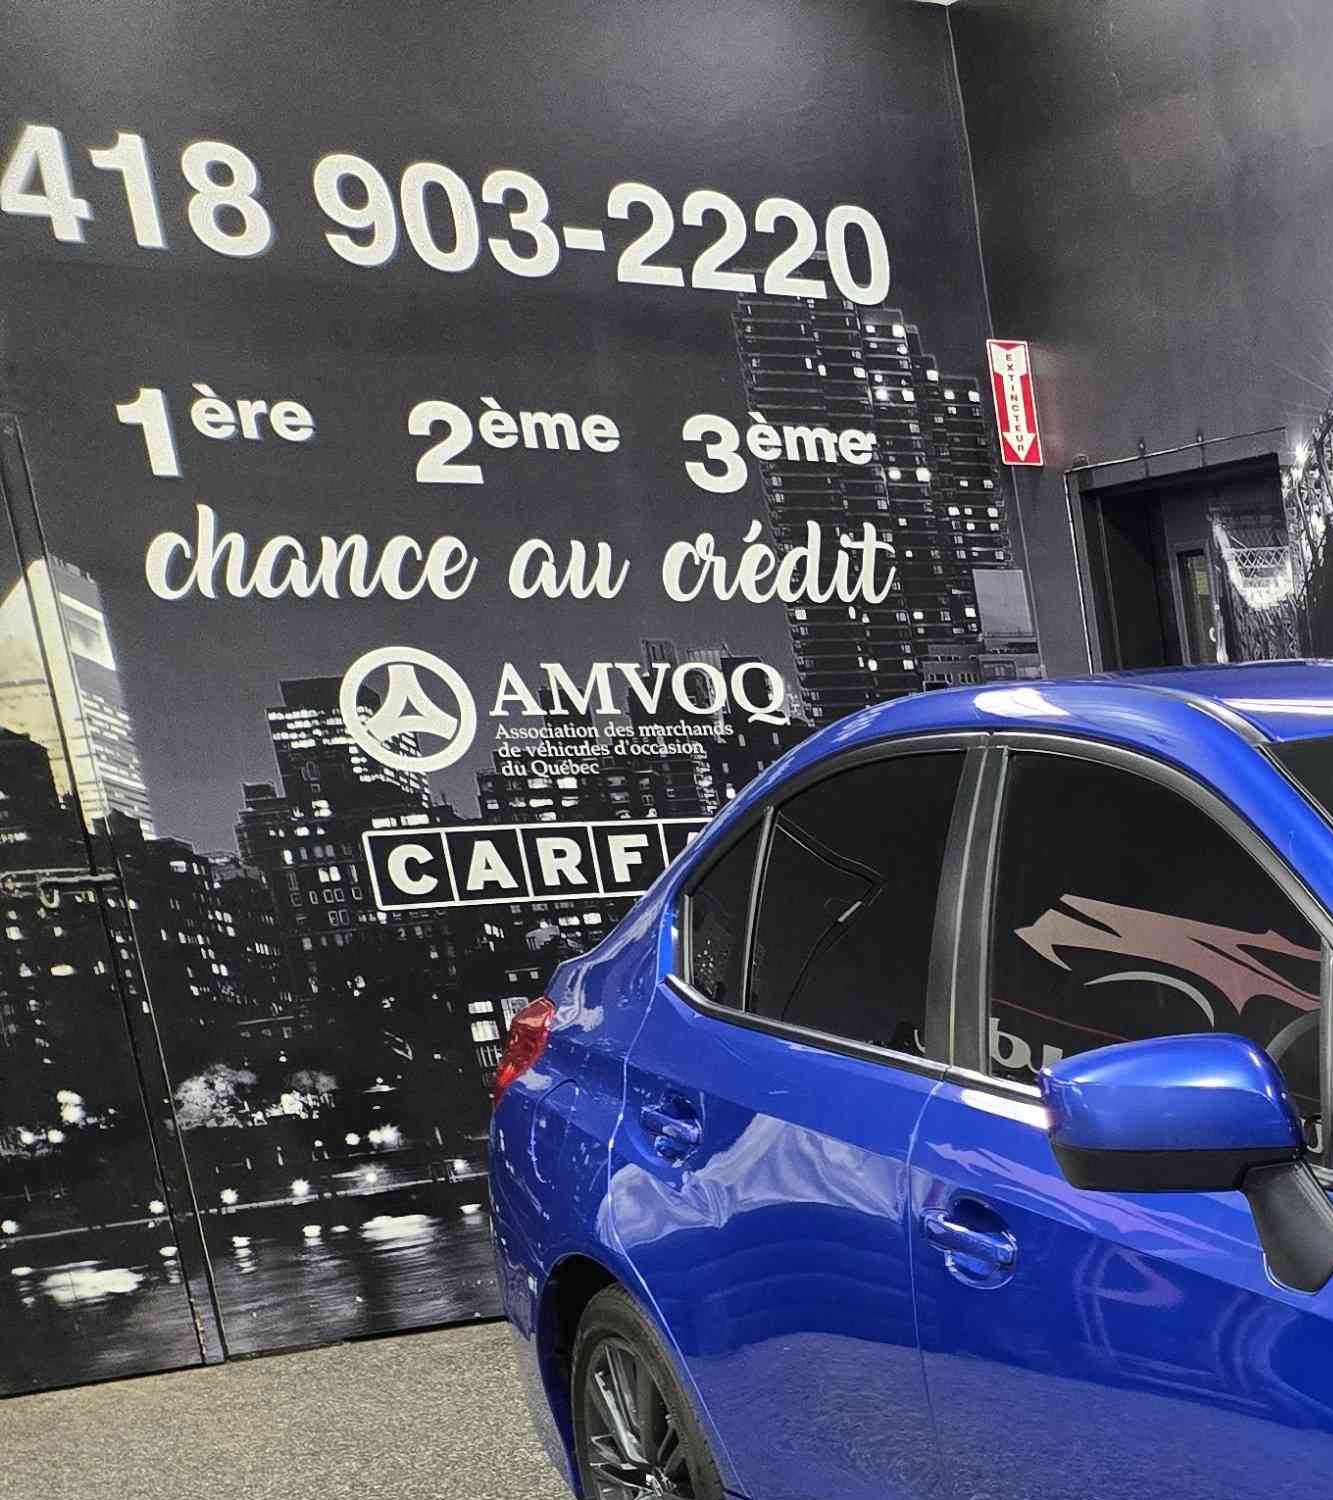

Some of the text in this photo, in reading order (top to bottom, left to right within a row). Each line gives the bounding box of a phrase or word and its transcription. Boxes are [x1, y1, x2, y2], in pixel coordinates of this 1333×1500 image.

[0, 124, 890, 306] 418 903-2220
[1004, 353, 1025, 452] EXTINCTEUR
[115, 384, 877, 494] 1ère 2ème 3ème
[146, 504, 896, 605] chance au crédit
[488, 661, 791, 726] AMVOQ
[494, 720, 735, 739] Association des marchands
[498, 739, 706, 758] de véhicules d'occasion
[501, 758, 600, 778] du Québec
[387, 831, 698, 896] CARF
